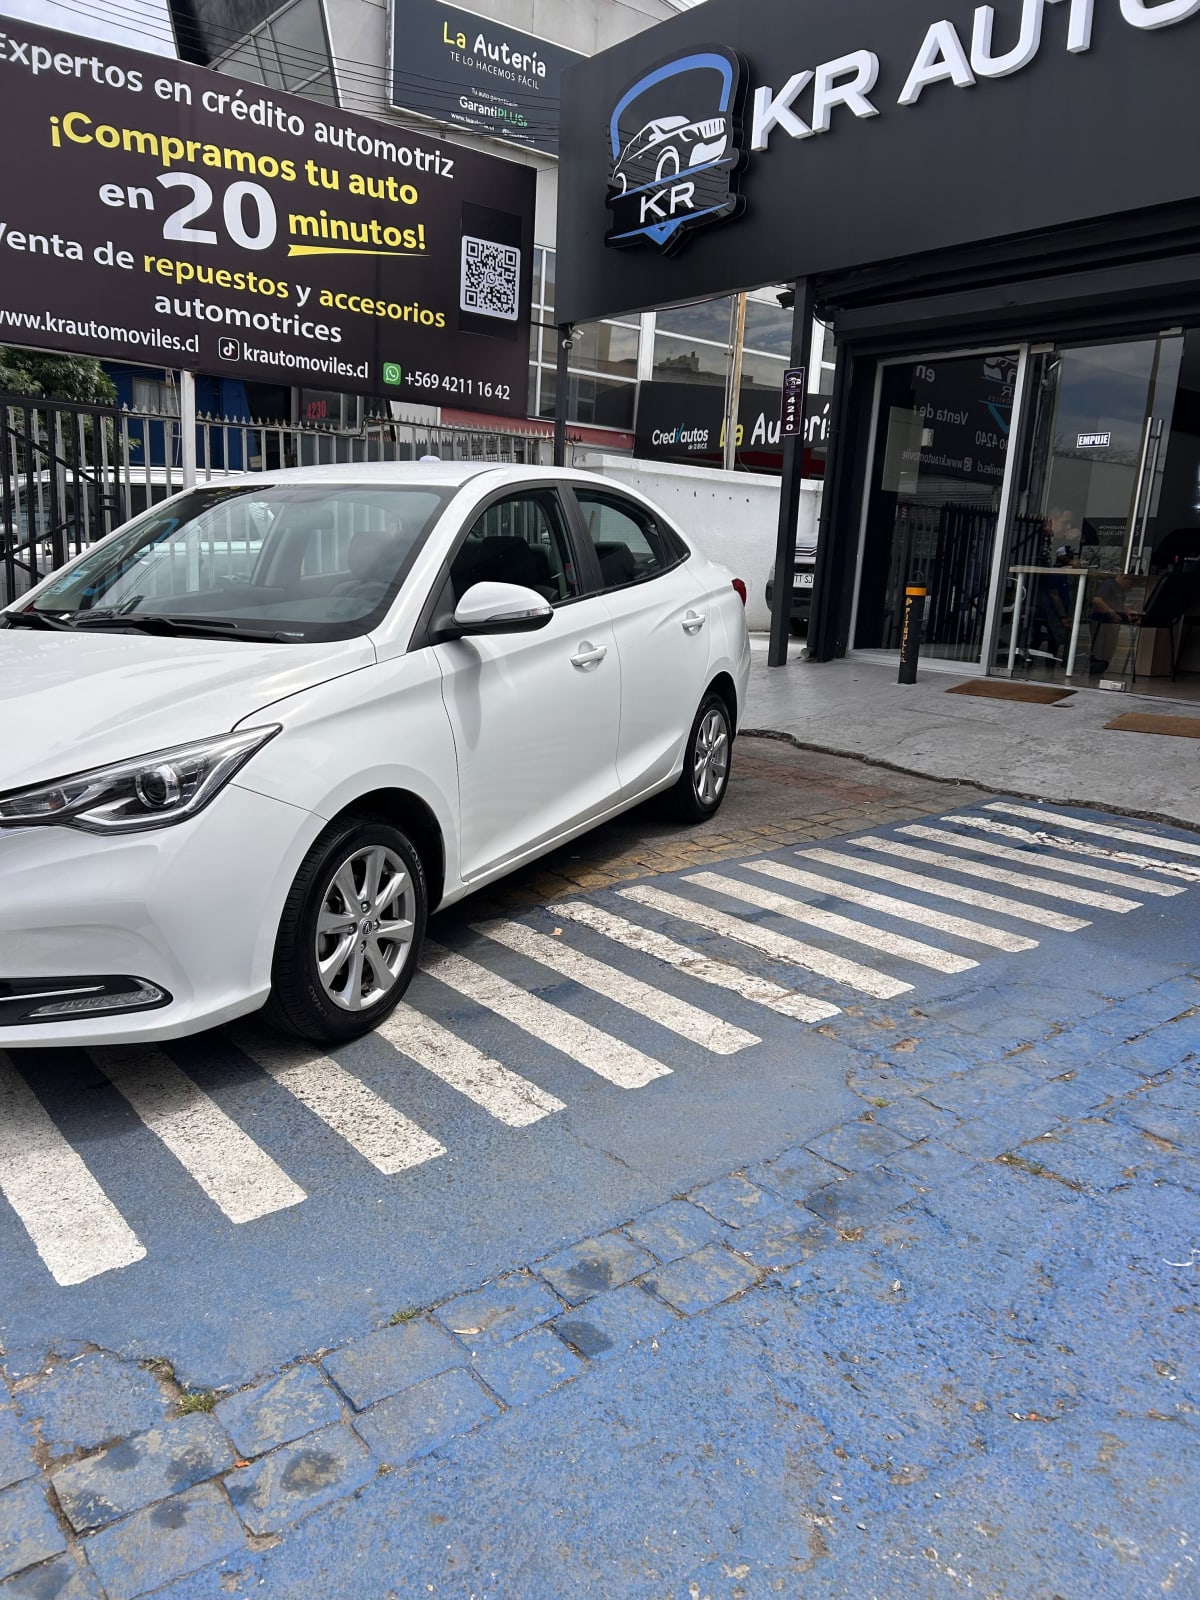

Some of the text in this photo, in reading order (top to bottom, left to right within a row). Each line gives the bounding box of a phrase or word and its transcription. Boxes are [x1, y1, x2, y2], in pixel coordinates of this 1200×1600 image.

[443, 21, 546, 78] La Autería
[450, 51, 460, 62] TE
[463, 56, 473, 66] LO
[476, 60, 515, 81] HACEMOS
[750, 49, 880, 152] KR
[155, 78, 192, 105] en
[202, 89, 305, 136] crédito
[314, 122, 454, 178] automotriz
[50, 111, 418, 205] ¡Compramos tu auto
[99, 172, 426, 251] en 20 minutos!
[639, 181, 695, 224] KR
[93, 241, 134, 270] de
[143, 255, 289, 298] repuestos
[295, 284, 311, 307] y
[319, 289, 446, 328] accesorios
[154, 295, 342, 343] automotrices
[243, 342, 369, 379] krautomoviles.cl
[405, 371, 510, 400] +569 4211 16 42
[751, 402, 830, 446] Aurí
[785, 396, 796, 431] 4240
[1079, 434, 1109, 446] EMPUJE
